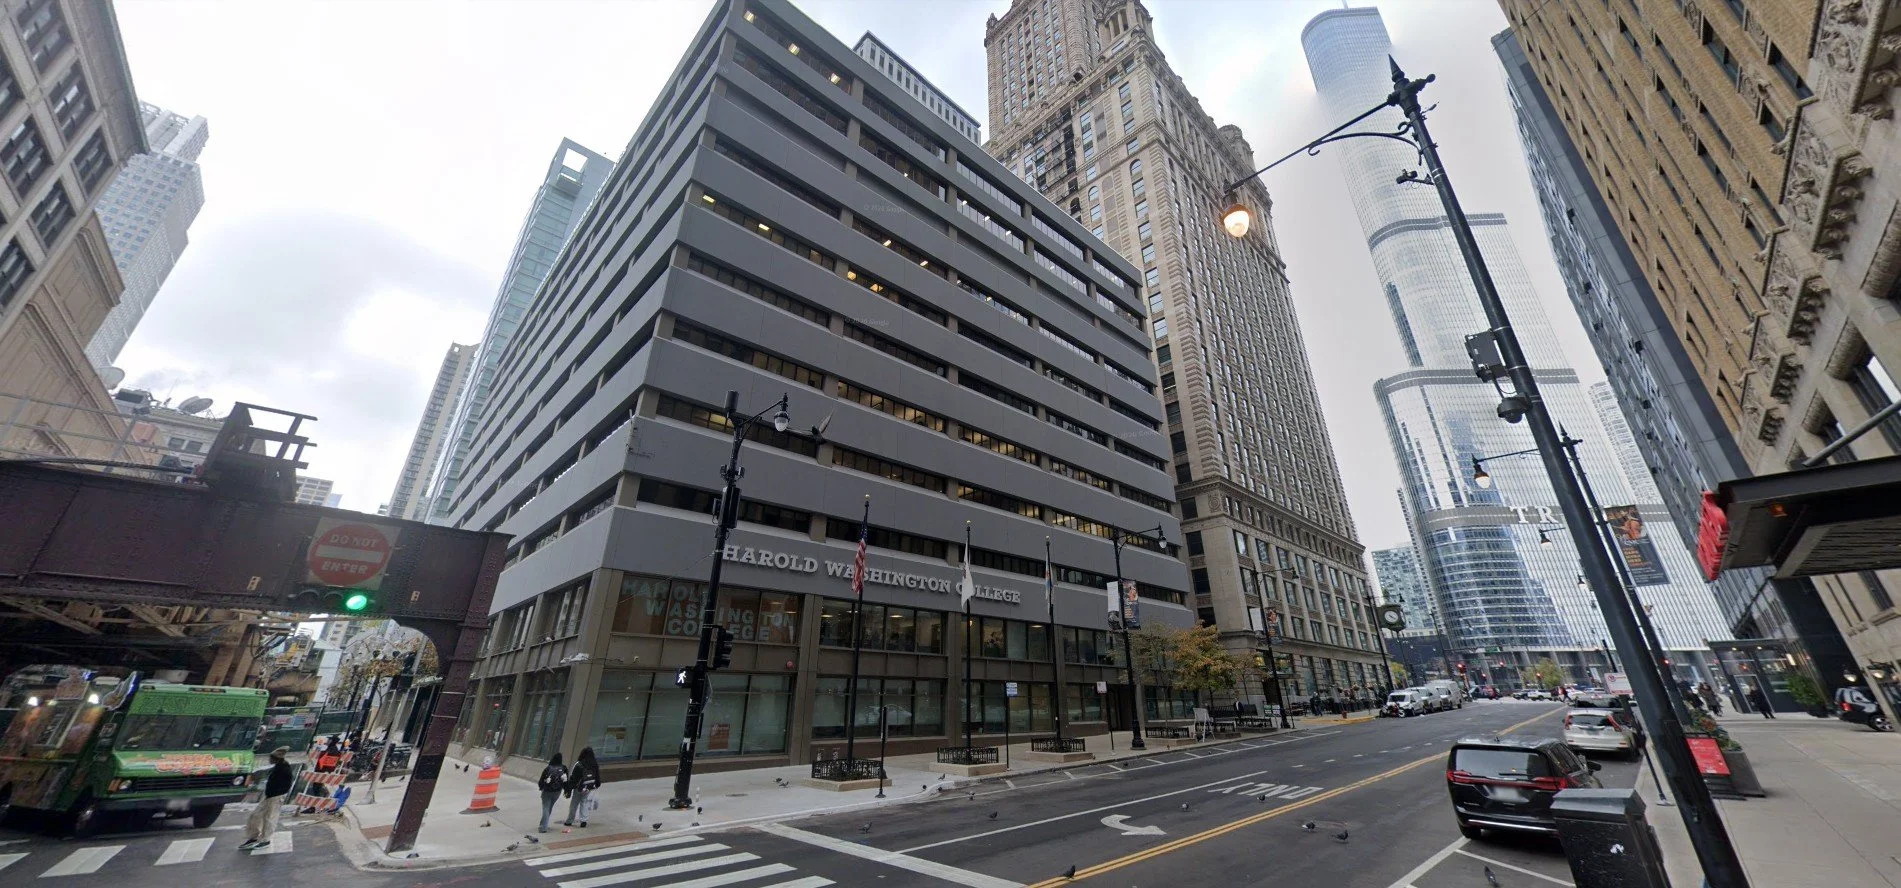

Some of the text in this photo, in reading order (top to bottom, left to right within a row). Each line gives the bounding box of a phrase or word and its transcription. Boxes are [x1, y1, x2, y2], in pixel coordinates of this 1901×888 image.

[330, 535, 377, 548] DO NOT
[321, 560, 368, 574] ENTER
[722, 544, 818, 573] HAROLD
[956, 581, 1021, 604] CLLEGE
[668, 618, 771, 641] COEGE
[1207, 782, 1324, 799] ONLY
